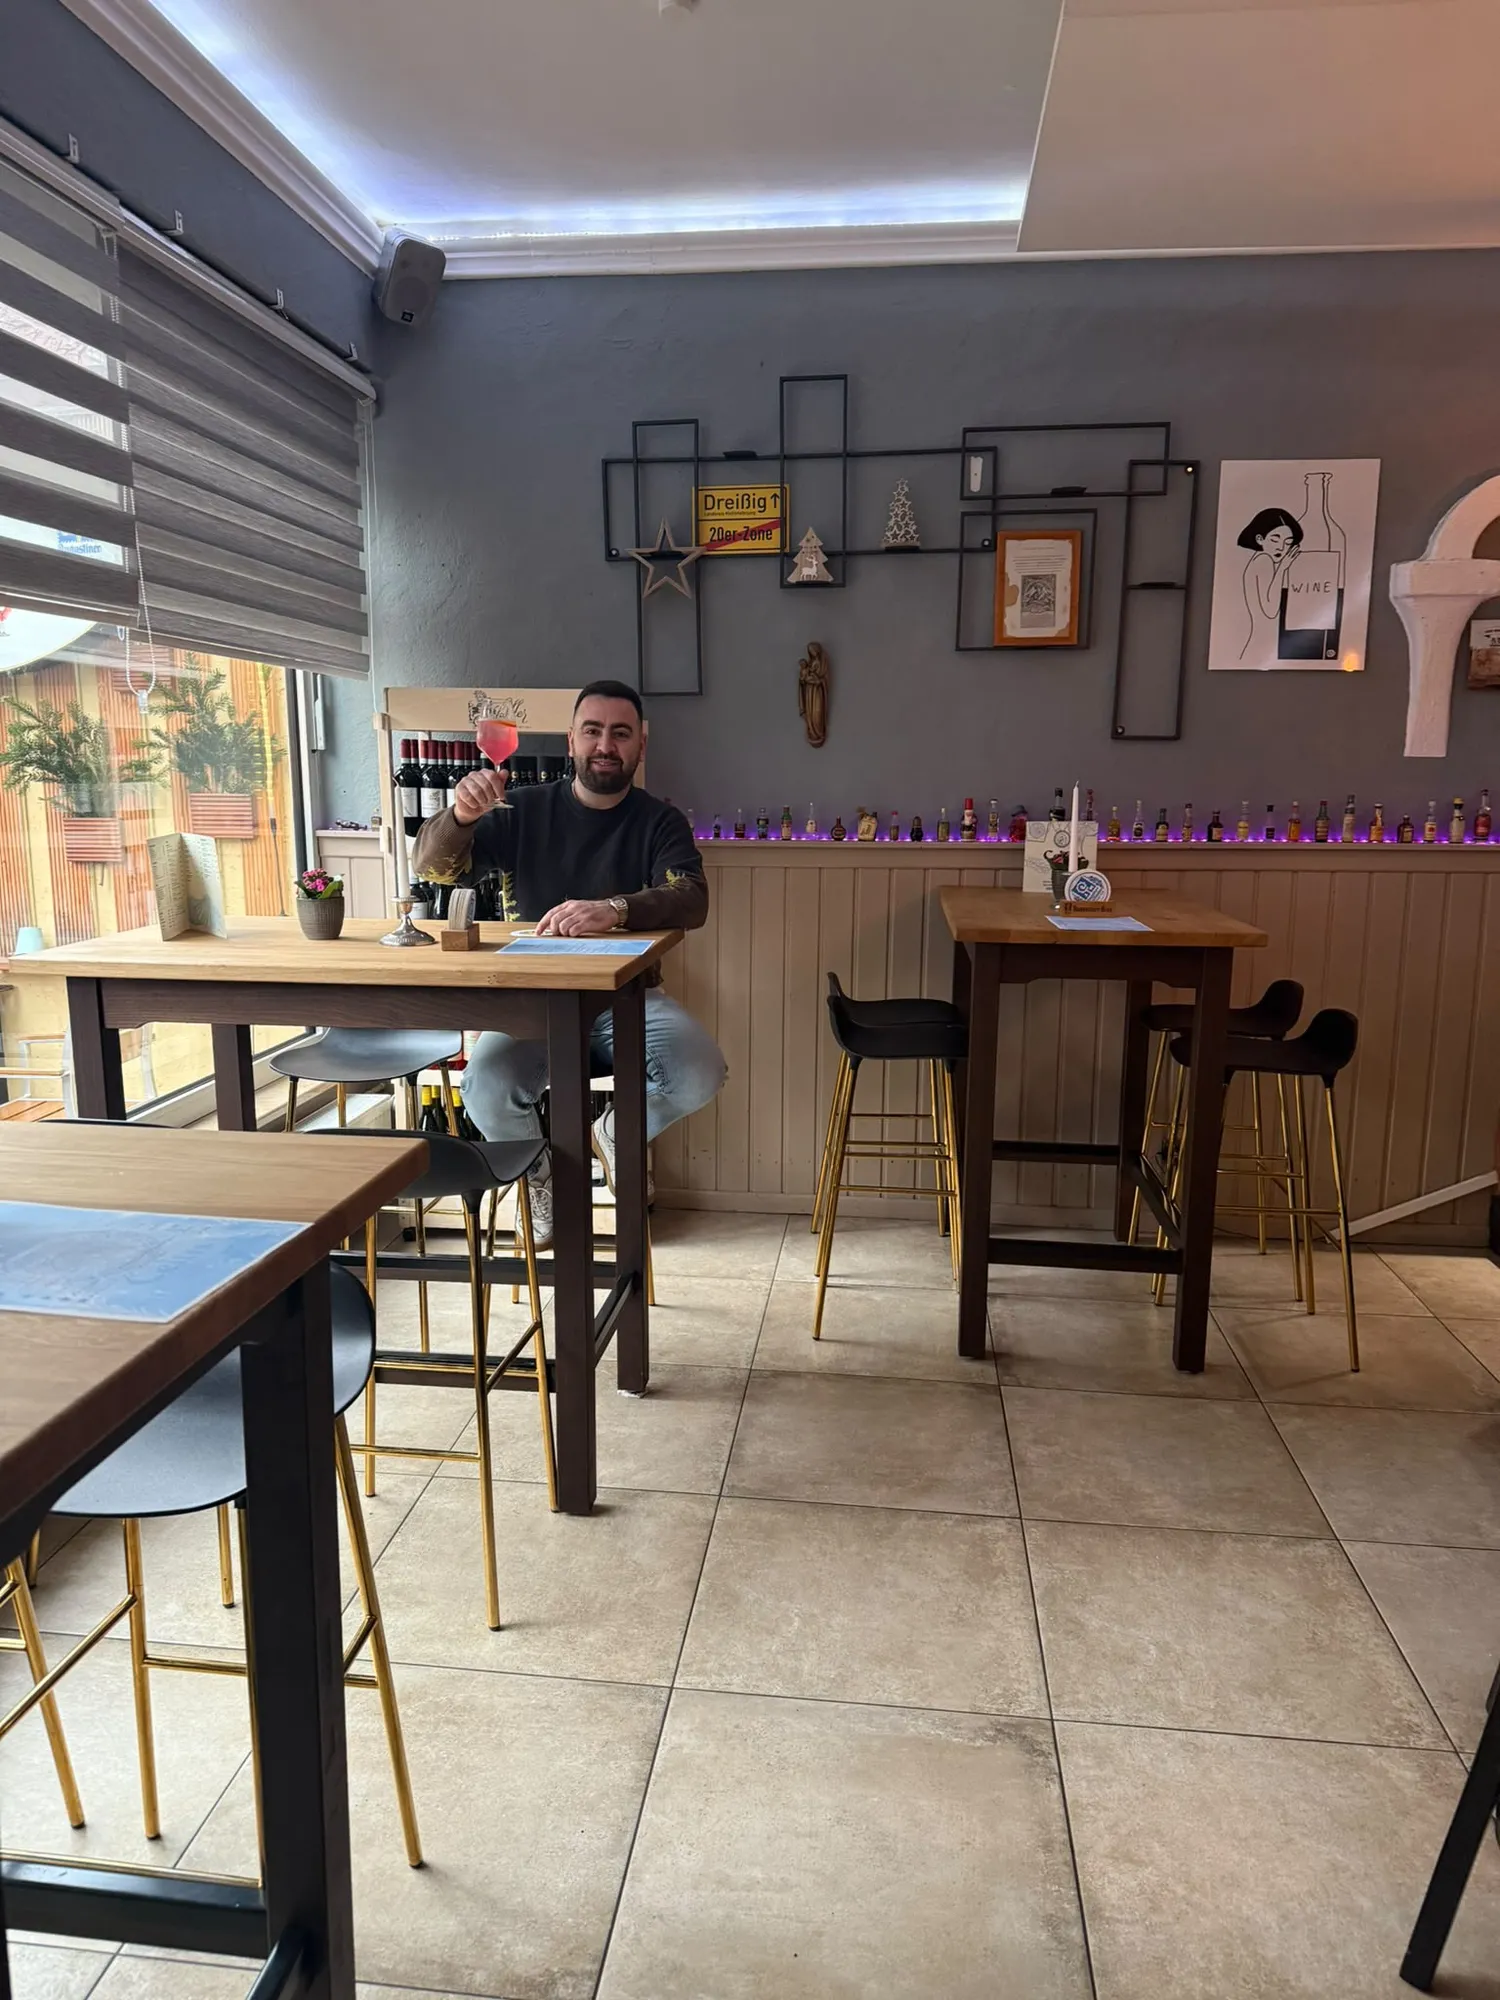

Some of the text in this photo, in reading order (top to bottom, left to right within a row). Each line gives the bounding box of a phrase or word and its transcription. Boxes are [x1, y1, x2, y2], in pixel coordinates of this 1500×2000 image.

[704, 493, 767, 513] Dreißig
[709, 525, 773, 543] 20er-Zone
[1291, 581, 1331, 594] WINE
